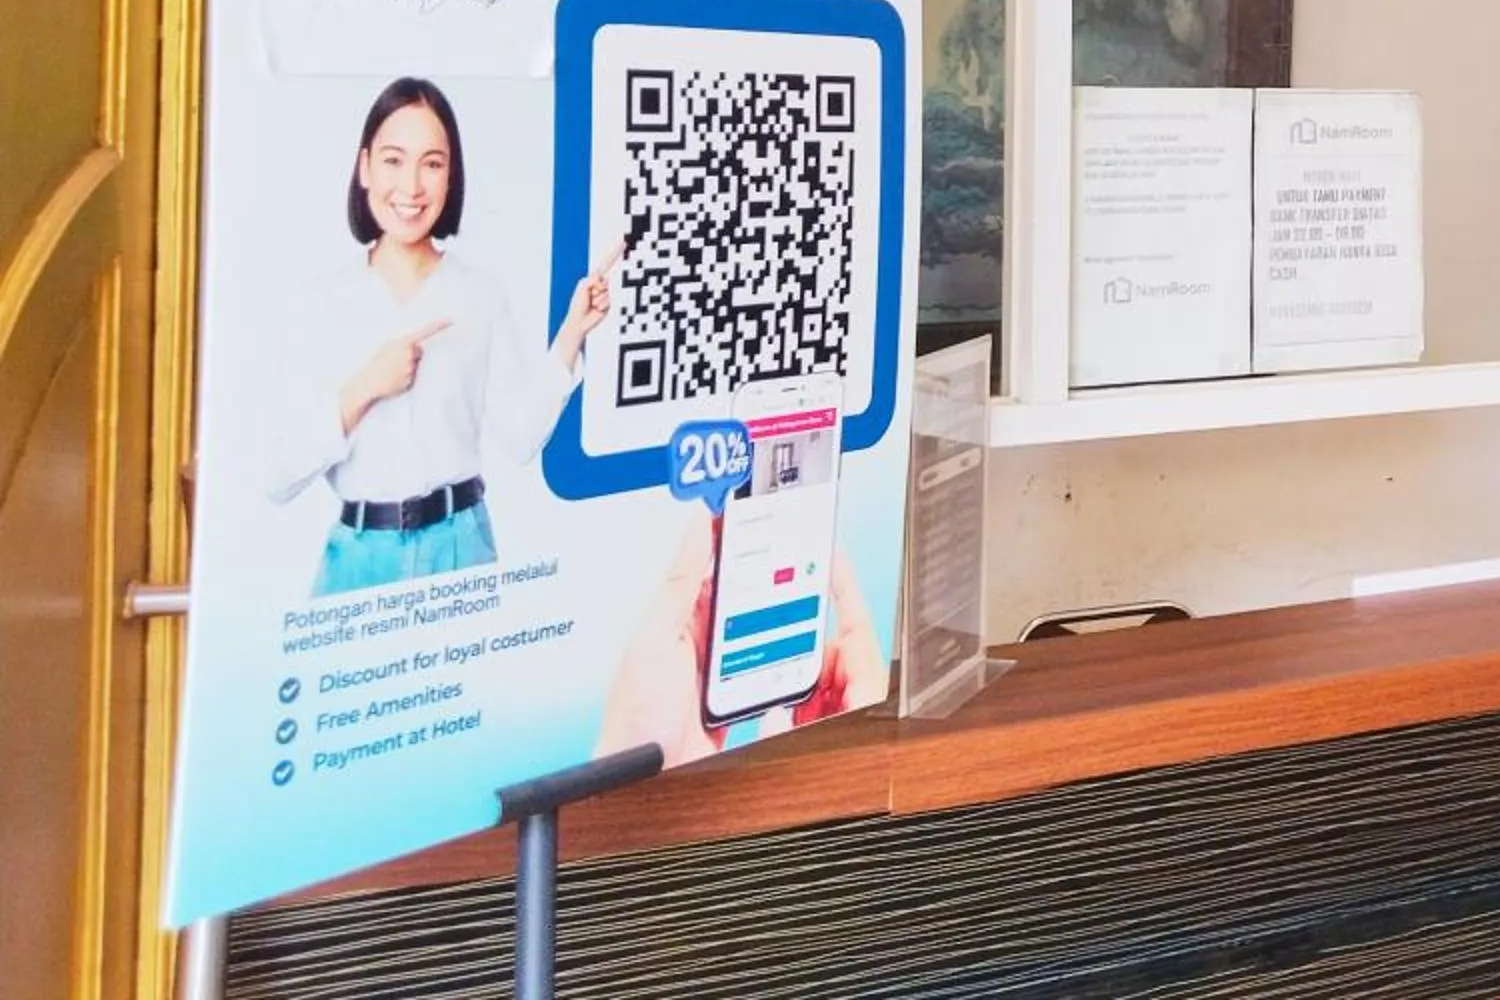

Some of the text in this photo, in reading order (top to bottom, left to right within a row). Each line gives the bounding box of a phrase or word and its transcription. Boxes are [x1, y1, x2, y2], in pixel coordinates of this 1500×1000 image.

[1341, 187, 1386, 201] PAYMENT
[728, 456, 749, 473] OFF
[283, 594, 500, 654] website resmi NamRoom
[284, 559, 558, 631] Potongan harga booking melalui
[319, 620, 574, 693] Discount for loyal costumer
[316, 681, 463, 733] Free Amenities
[313, 711, 481, 771] Payment at Hotel
